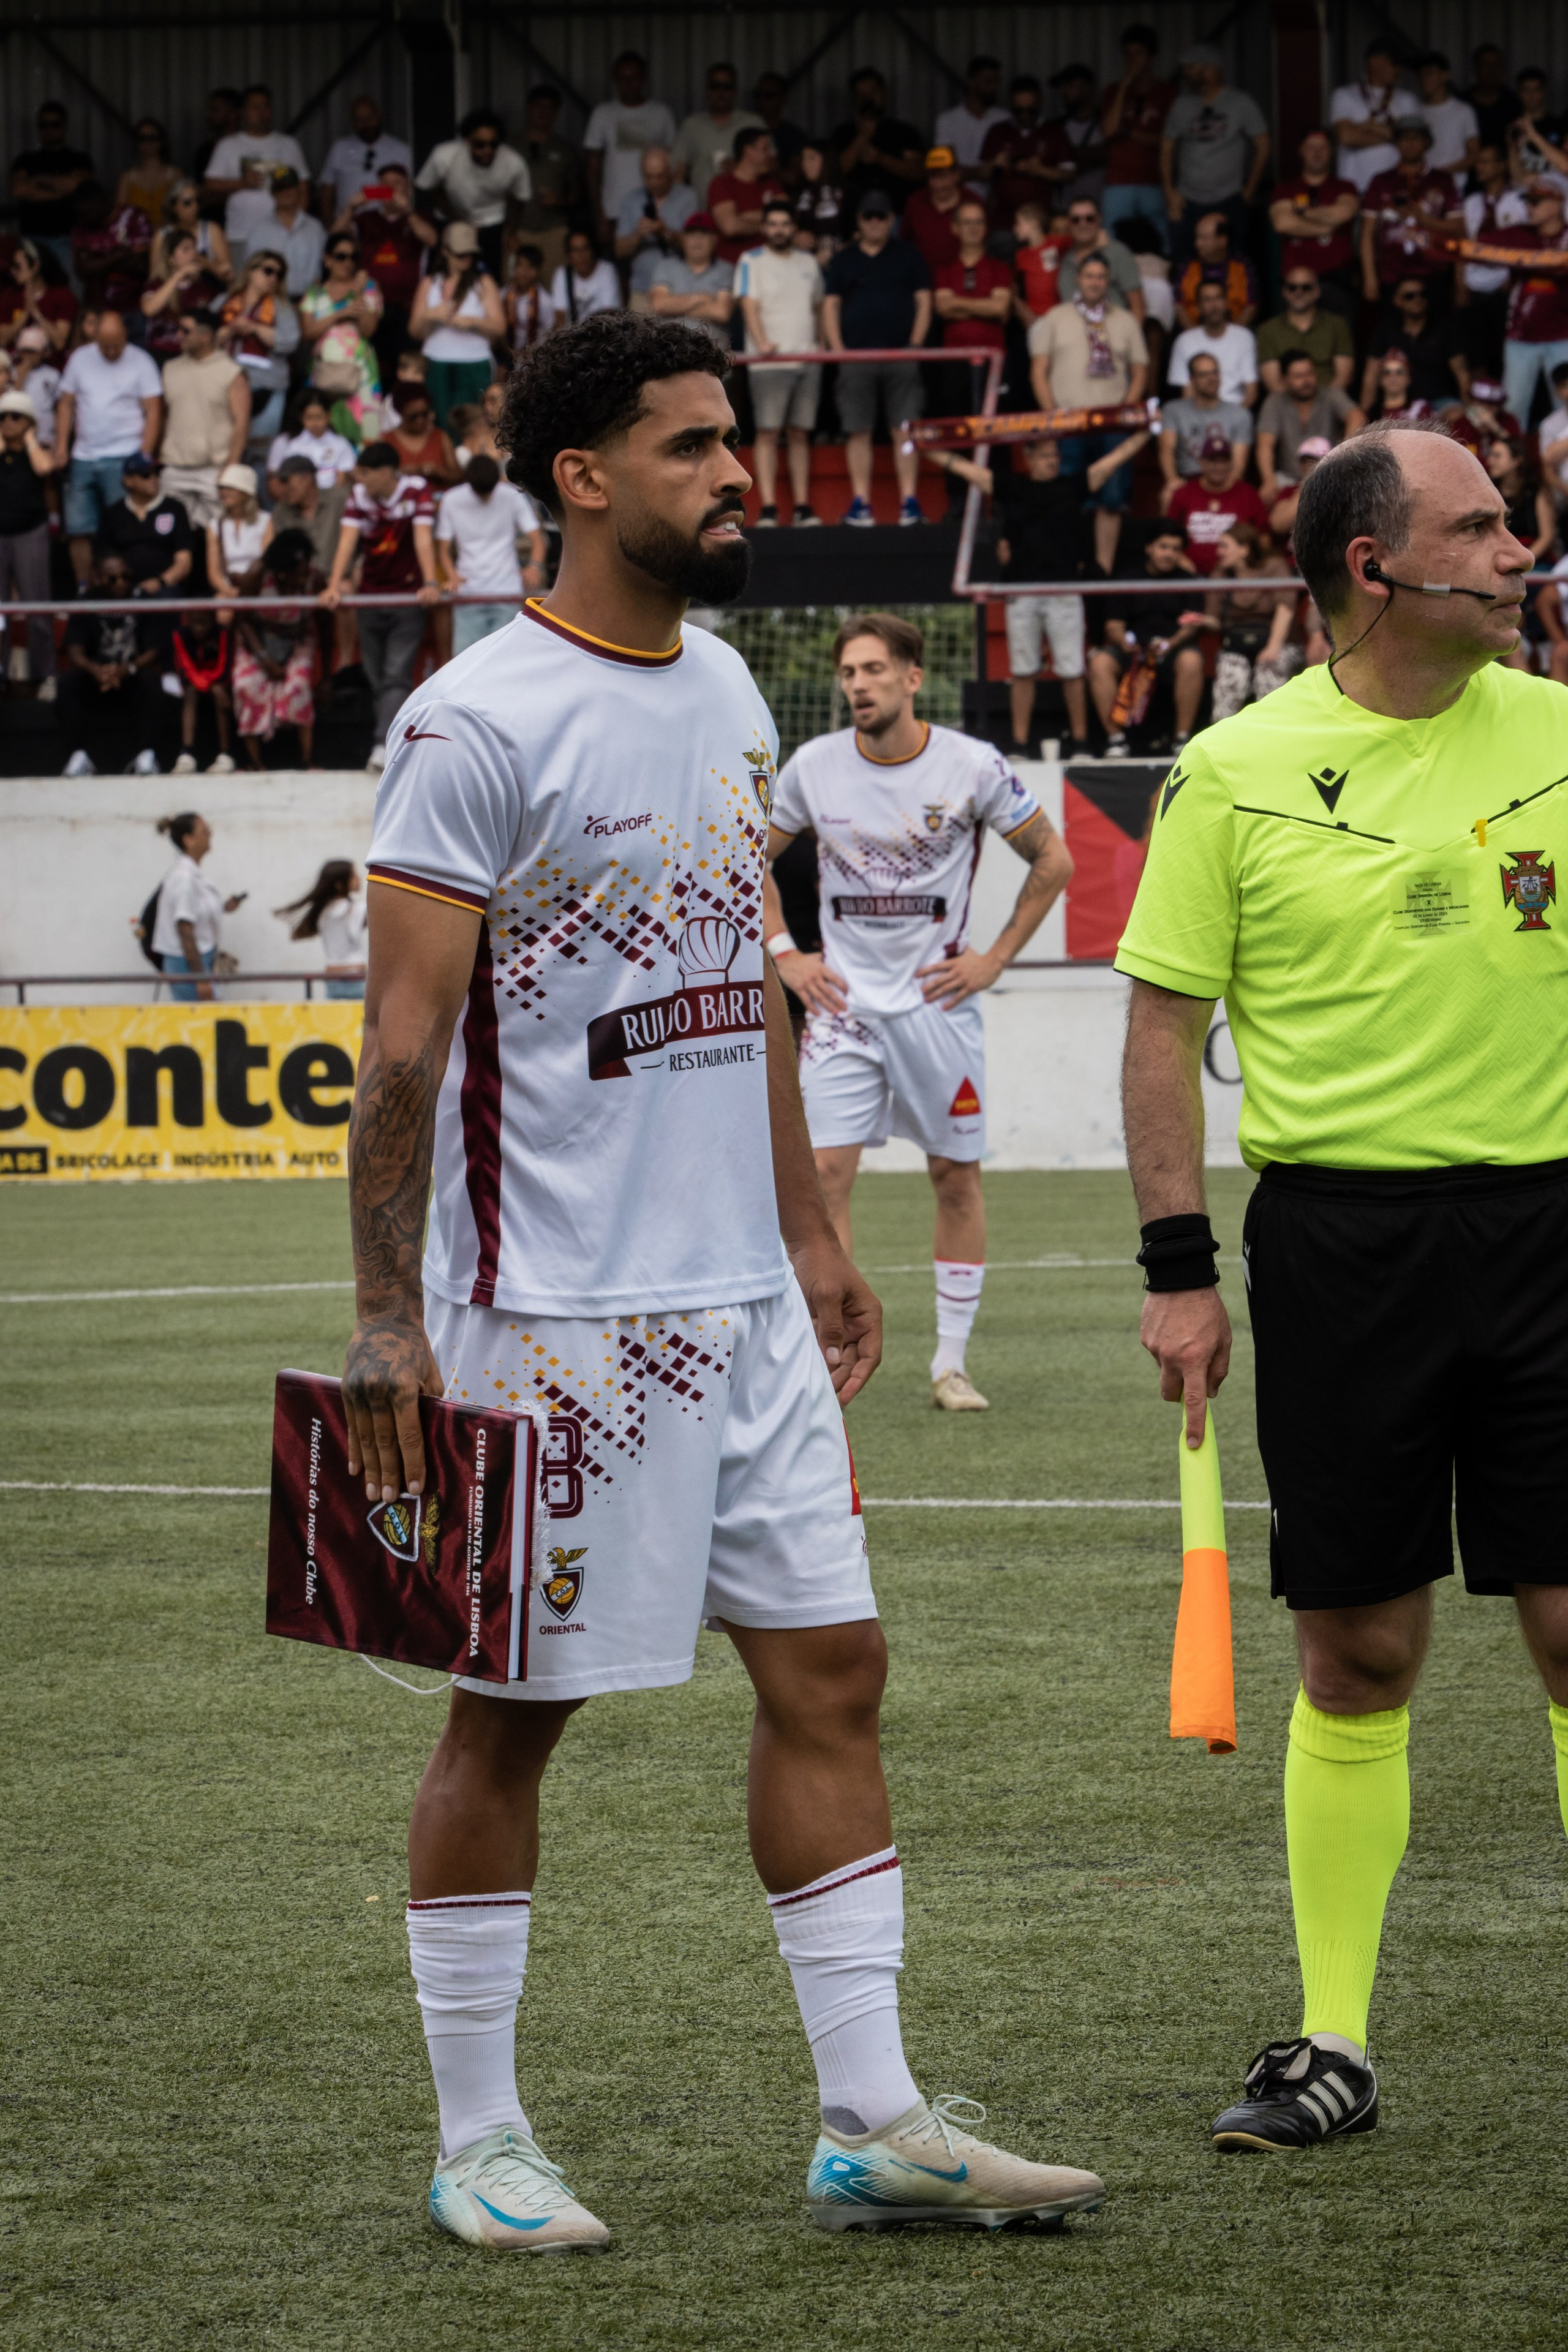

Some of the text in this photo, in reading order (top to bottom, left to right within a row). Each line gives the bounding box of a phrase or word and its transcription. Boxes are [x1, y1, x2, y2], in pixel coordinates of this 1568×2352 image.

[594, 813, 652, 839] PLAYOFF
[669, 1044, 755, 1071] RESTAURANTE
[56, 1152, 159, 1168] BRICOLAGE
[174, 1148, 274, 1167] INDÚSTRIA
[290, 1152, 341, 1167] AUTO
[306, 1417, 322, 1605] Histórias do nosso Clube
[467, 1519, 472, 1529] EM
[467, 1535, 472, 1544] DE
[469, 1428, 486, 1657] CLUBE ORIENTAL DE LISBOA
[466, 1572, 470, 1581] DE
[539, 1623, 586, 1635] ORIENTAL
